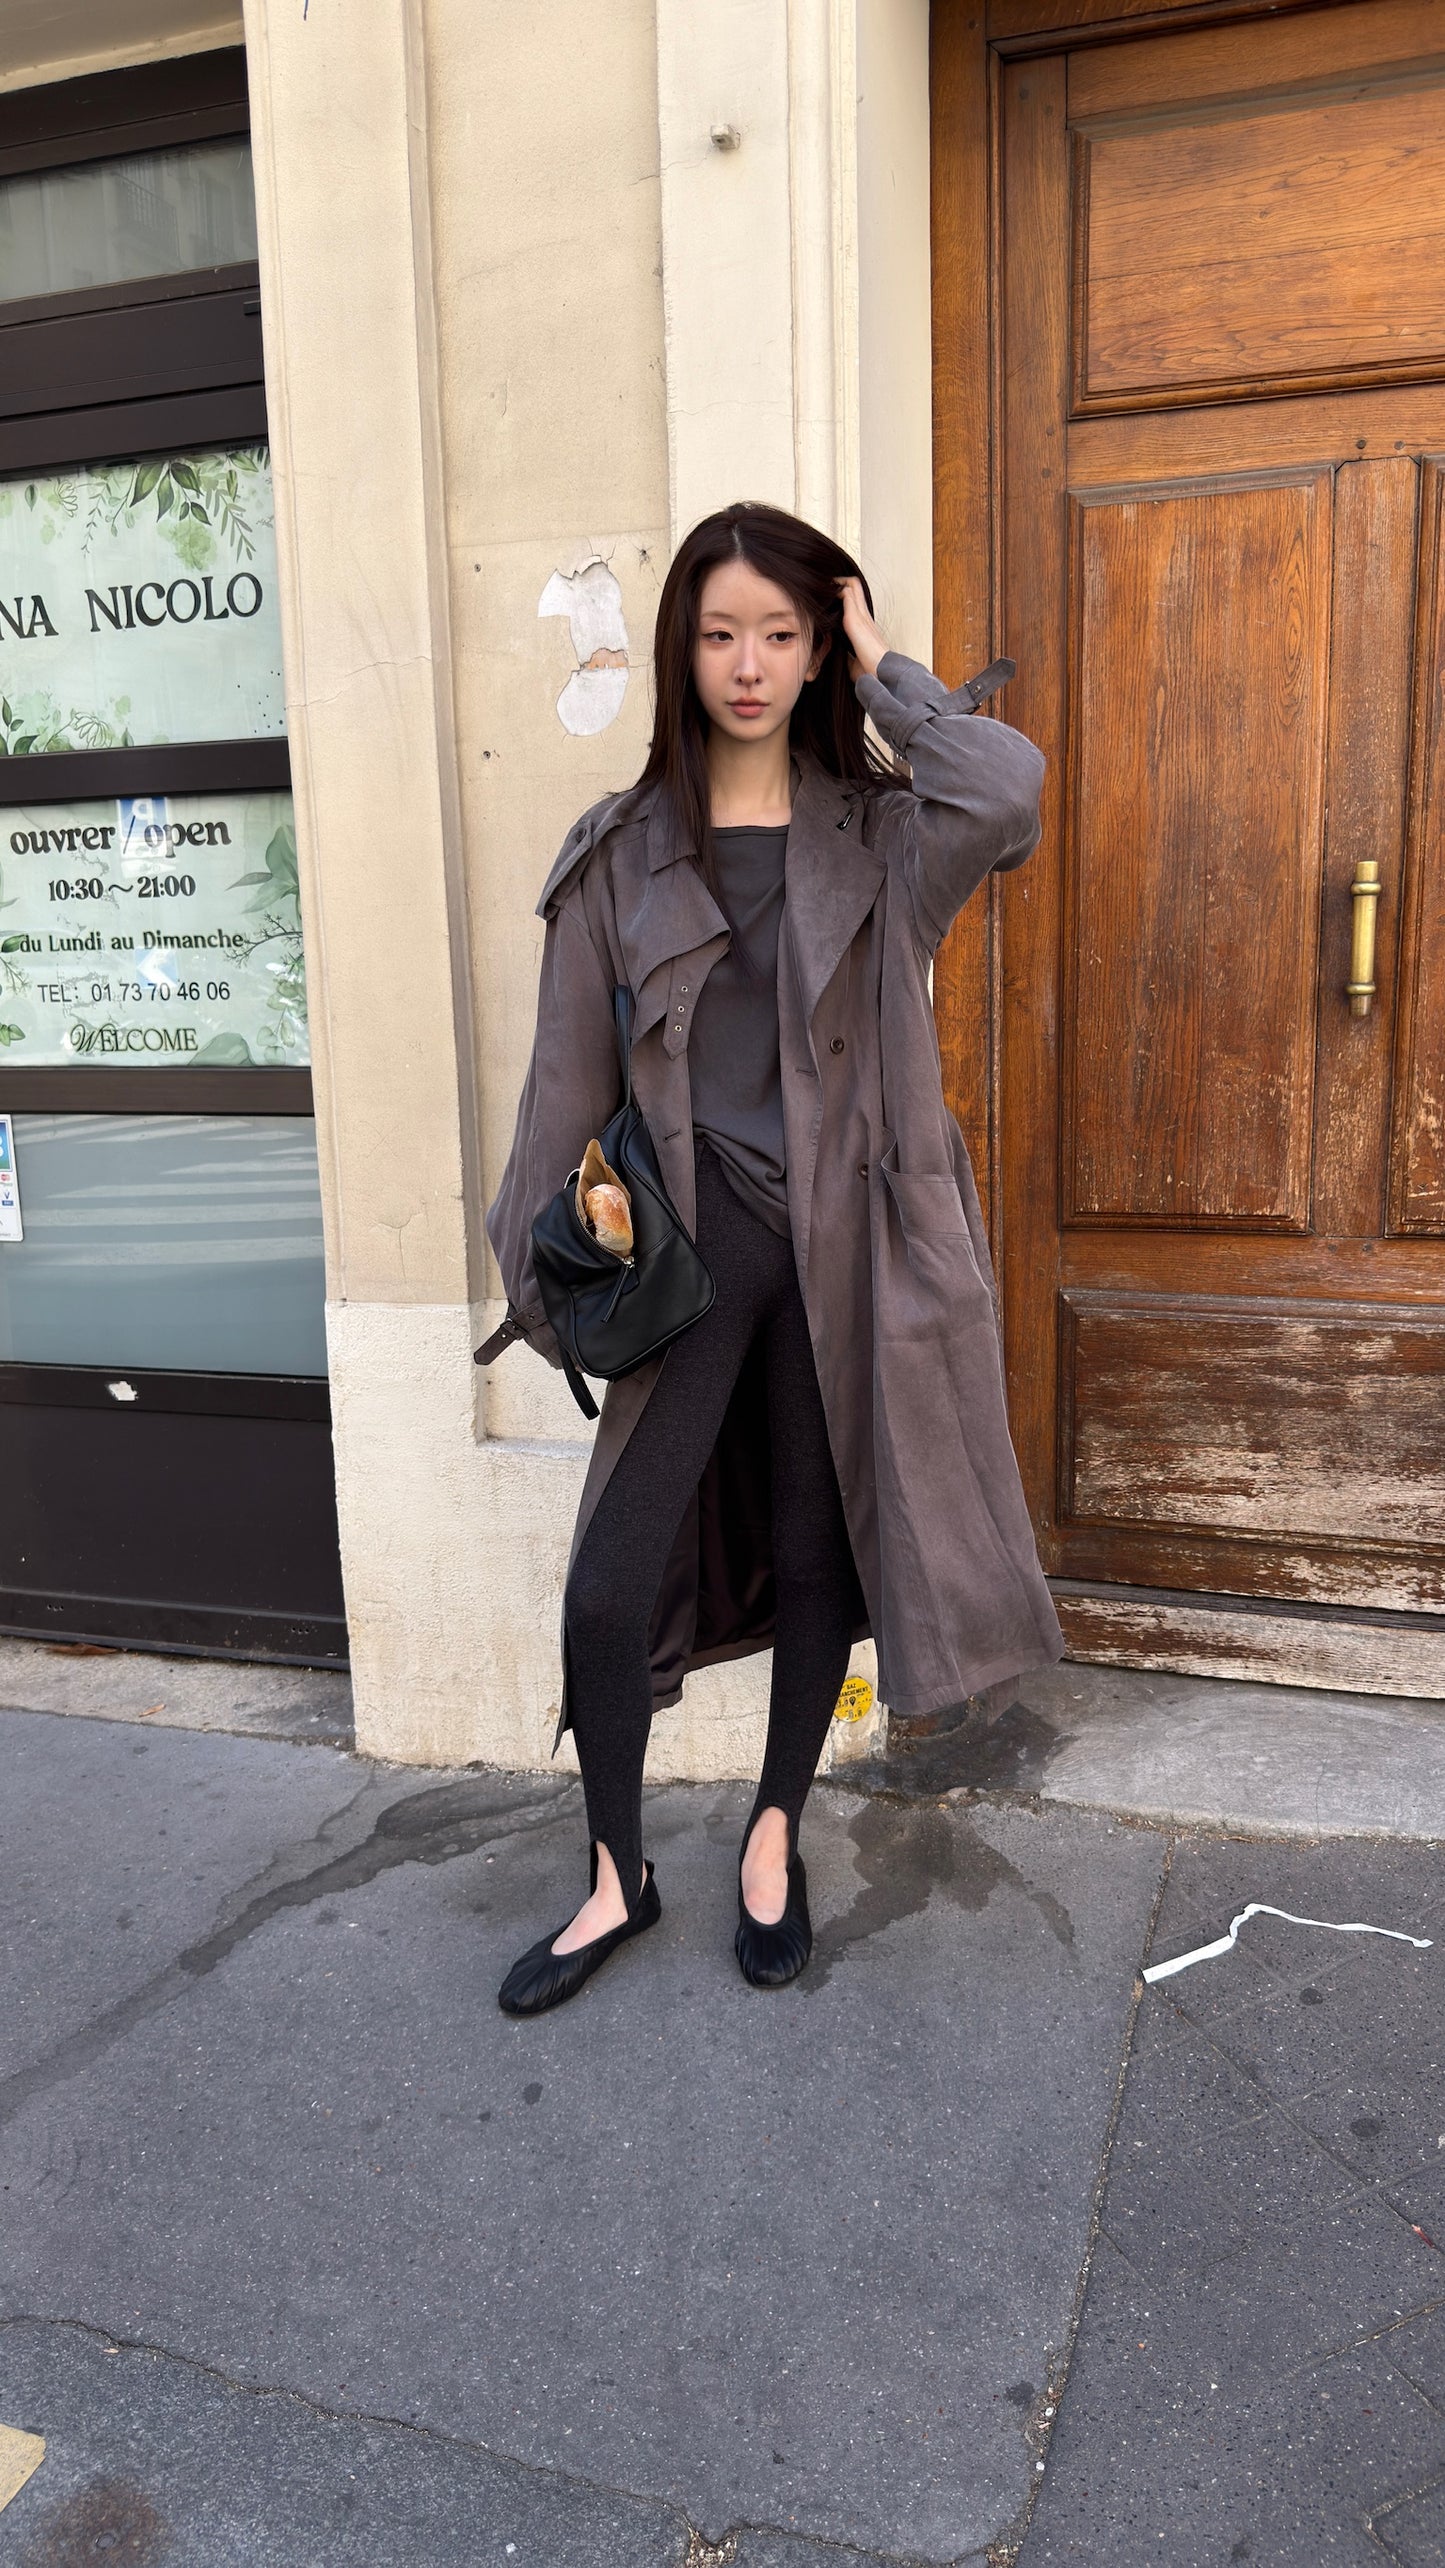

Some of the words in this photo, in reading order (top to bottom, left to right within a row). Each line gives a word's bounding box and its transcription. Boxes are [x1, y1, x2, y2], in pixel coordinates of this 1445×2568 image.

[85, 572, 263, 632] NICOLO
[10, 827, 116, 855] ouvrer
[144, 821, 232, 858] open
[20, 934, 42, 953] du
[49, 931, 102, 952] Lundi
[111, 936, 135, 950] au
[143, 929, 244, 950] Dimanche
[91, 983, 112, 1002] 01
[120, 982, 142, 1001] 73
[148, 982, 171, 1001] 70
[177, 981, 200, 1001] 46
[207, 981, 231, 1000] 06
[70, 1023, 198, 1052] WELCOME
